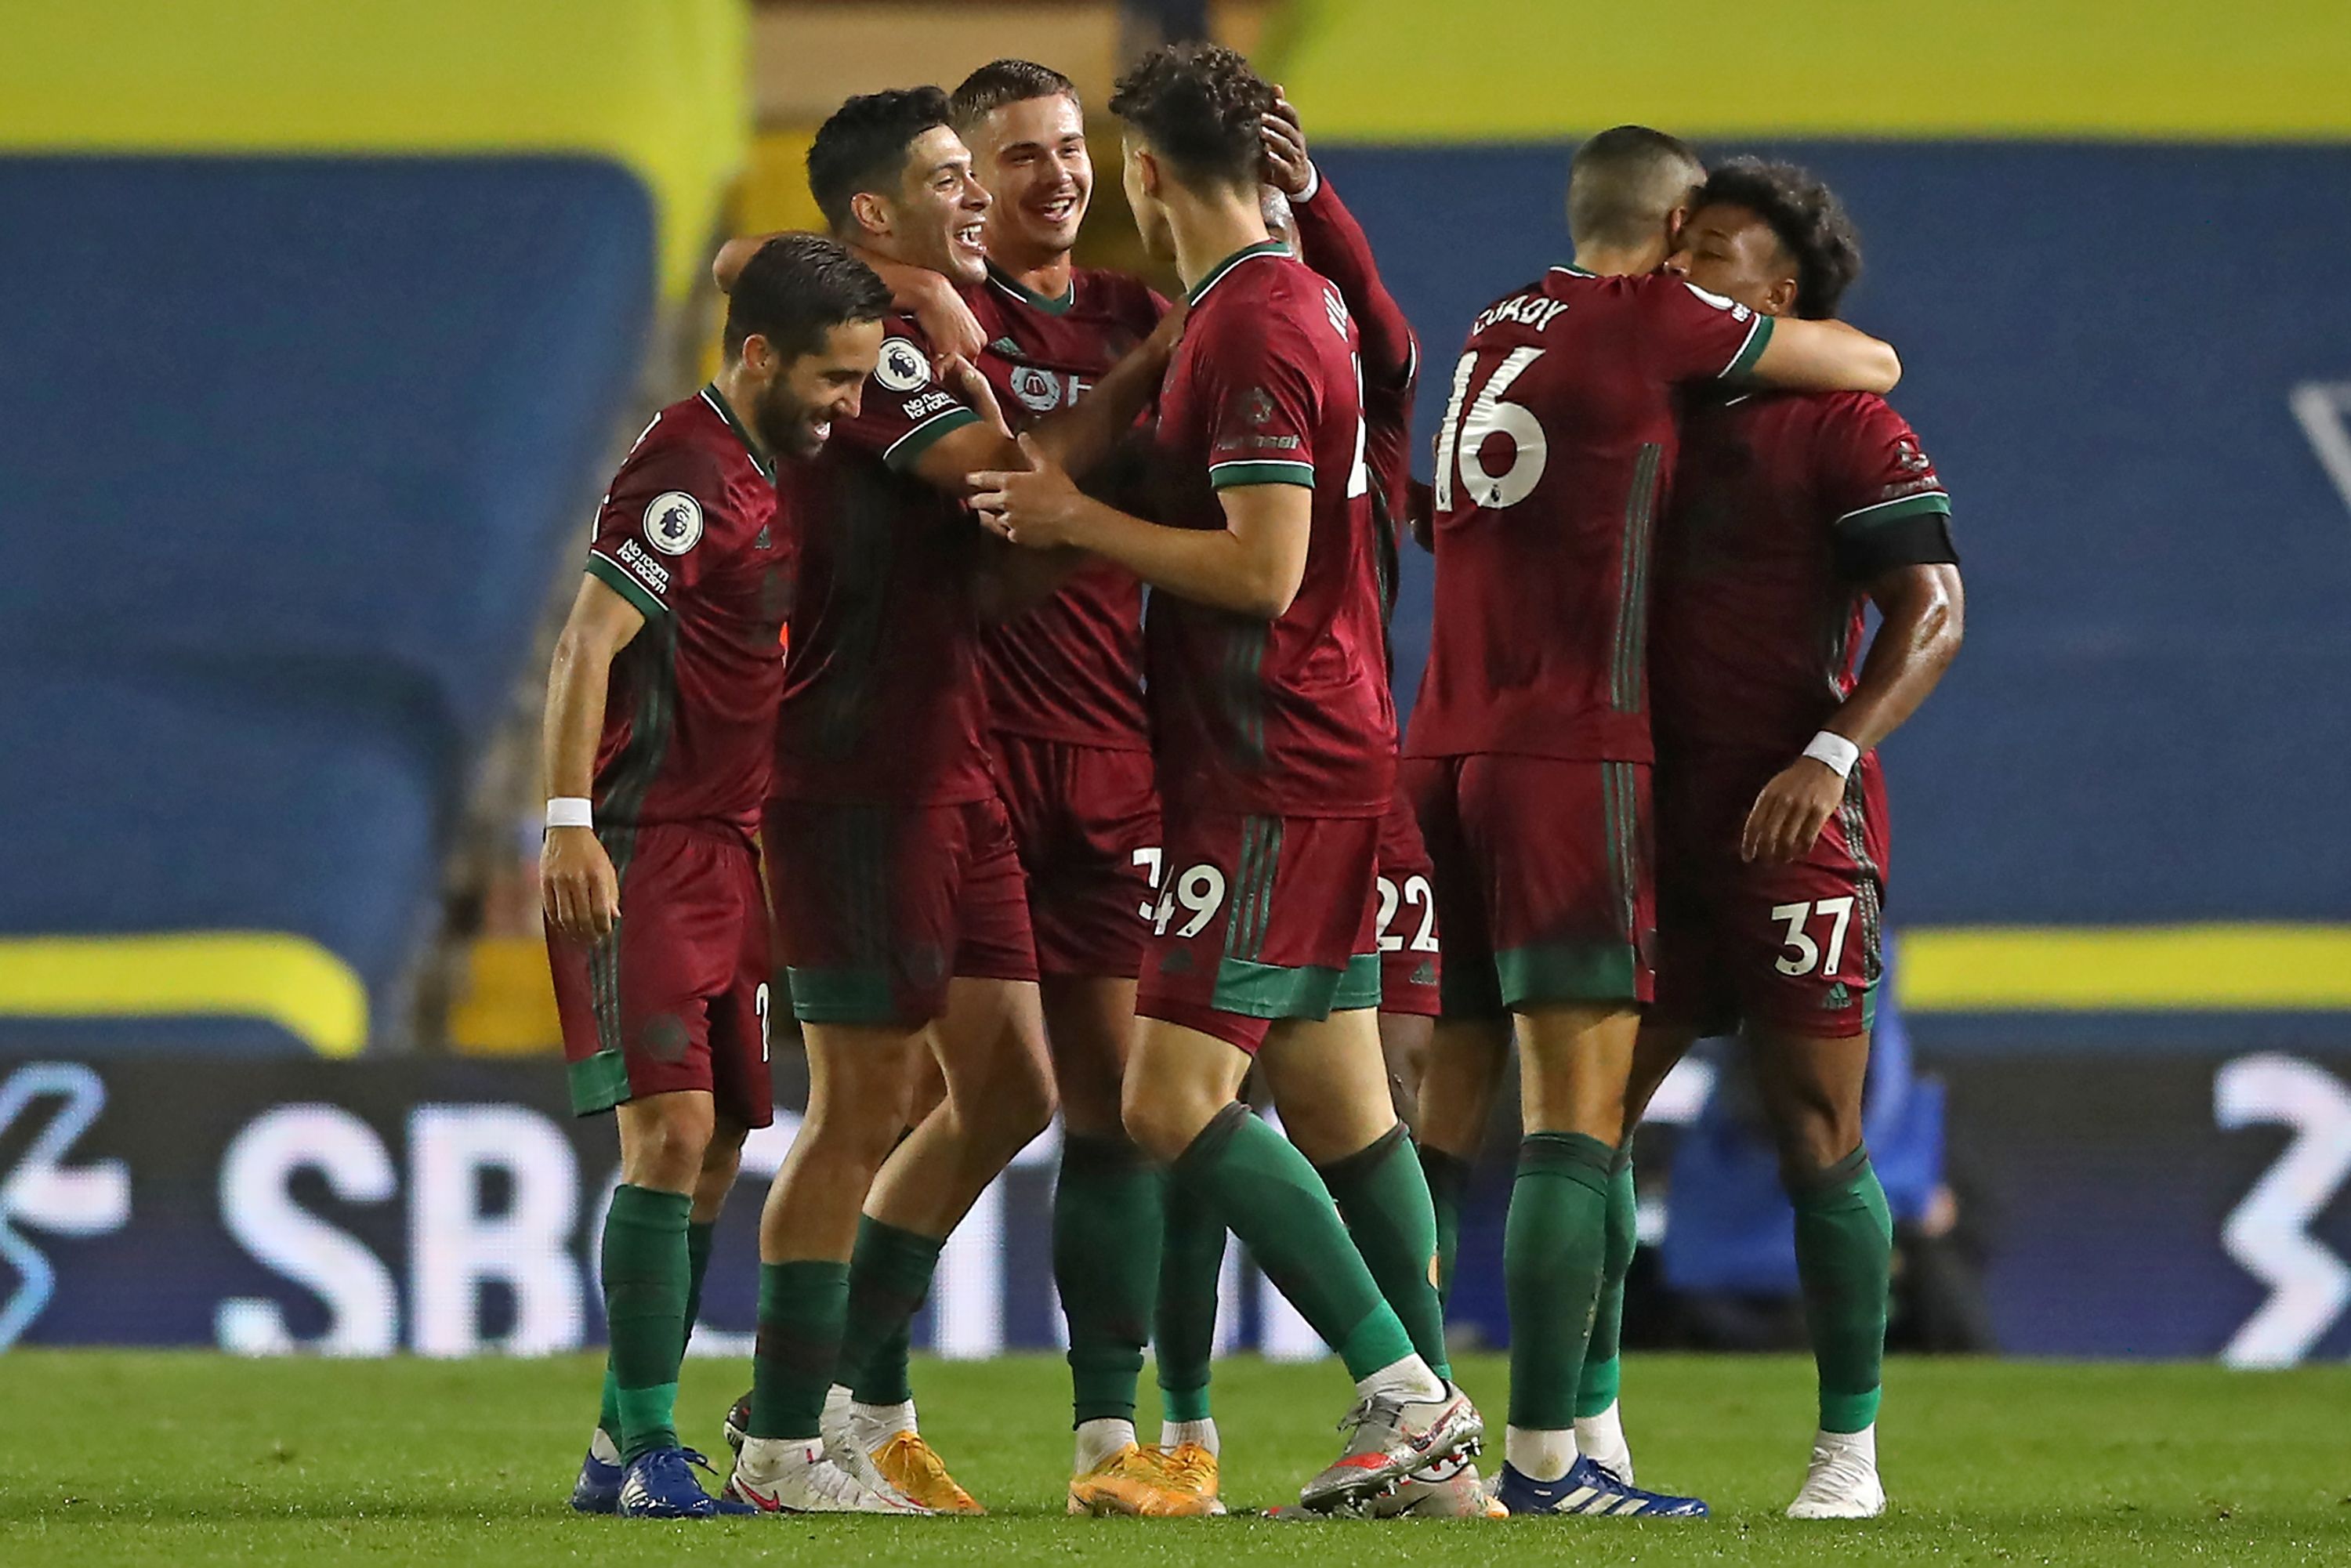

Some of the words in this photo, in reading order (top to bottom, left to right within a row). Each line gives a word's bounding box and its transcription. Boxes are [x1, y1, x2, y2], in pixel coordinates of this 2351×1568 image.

[1435, 346, 1549, 512] 16
[1377, 875, 1440, 952] 22
[1771, 896, 1855, 976] 37
